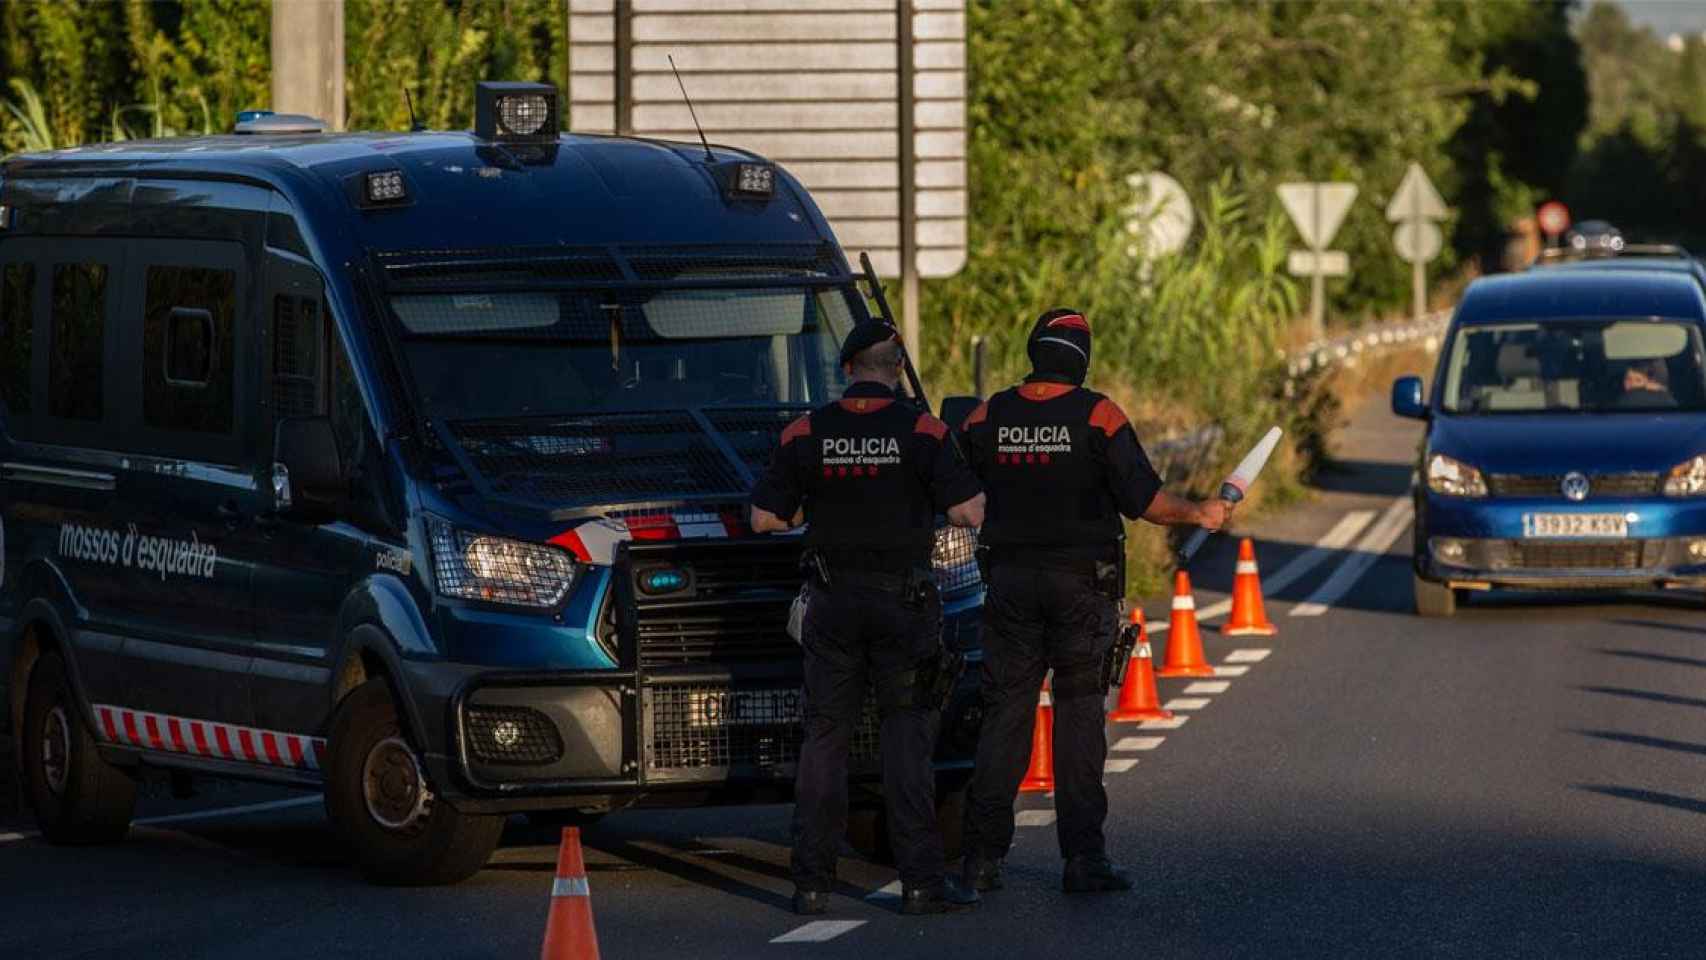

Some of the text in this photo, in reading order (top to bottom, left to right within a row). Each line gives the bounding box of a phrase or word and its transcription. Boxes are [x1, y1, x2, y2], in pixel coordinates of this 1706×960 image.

[998, 426, 1071, 443] POLICIA
[823, 438, 900, 455] POLICIA
[59, 524, 120, 564] mossos
